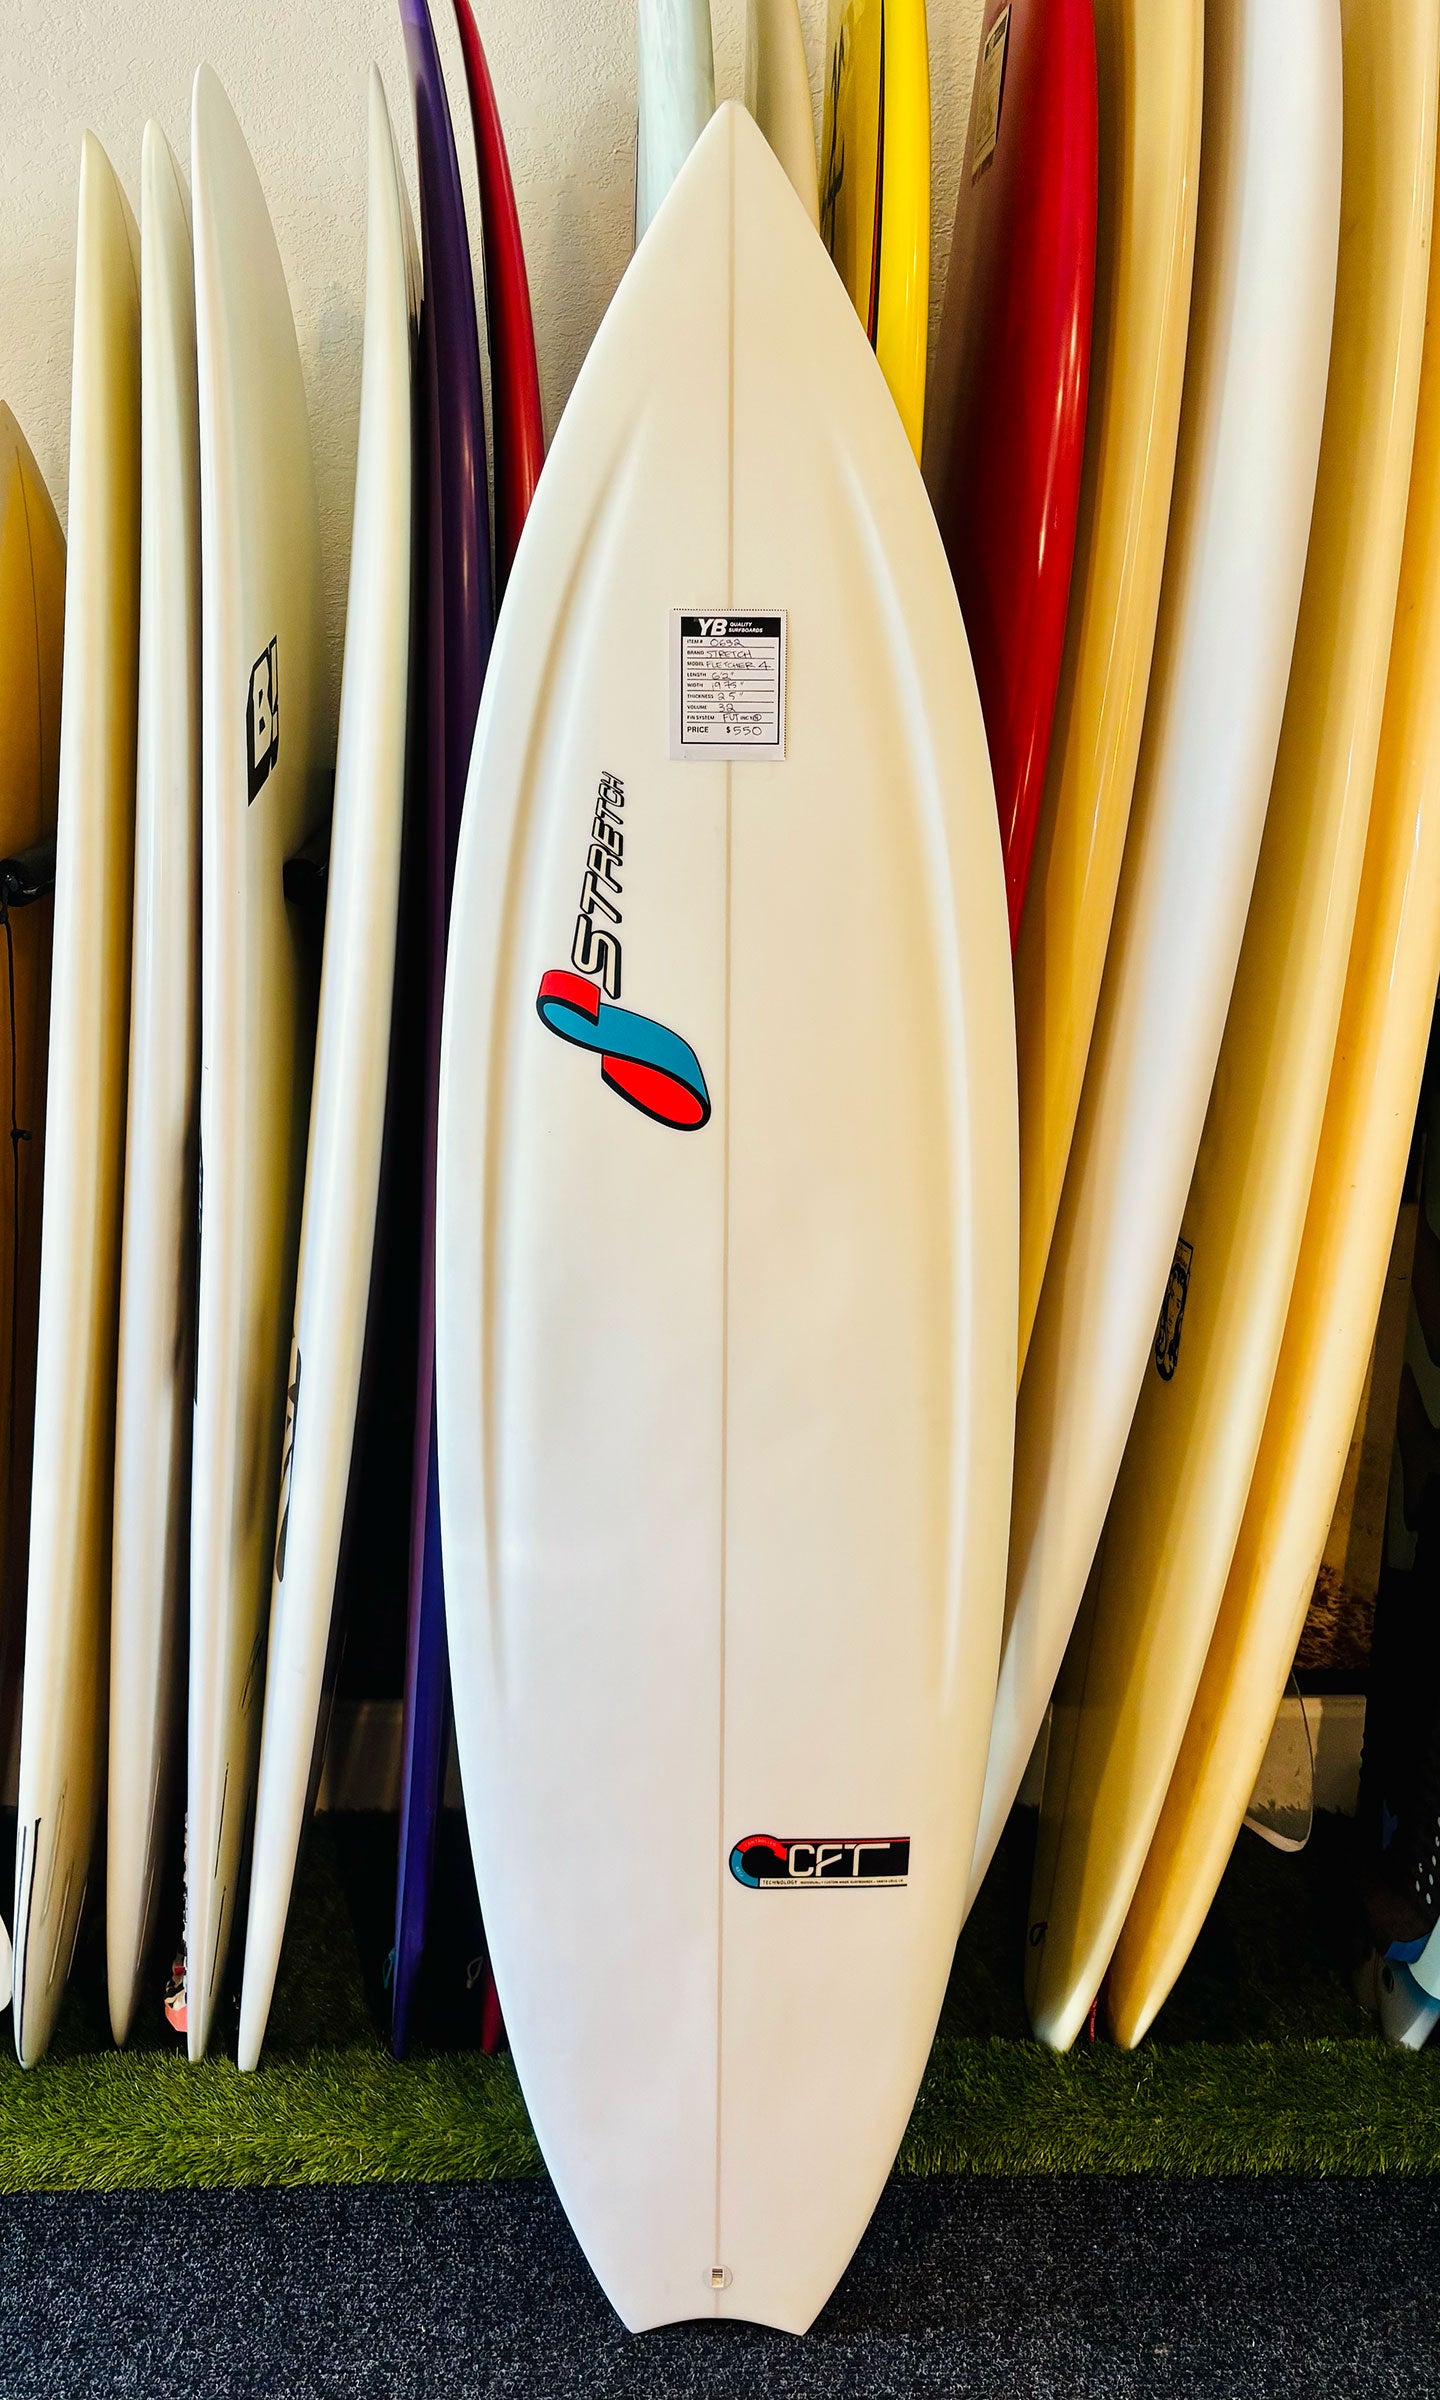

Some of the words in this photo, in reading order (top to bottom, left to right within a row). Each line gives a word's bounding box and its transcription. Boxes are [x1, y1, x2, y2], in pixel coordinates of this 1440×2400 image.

[698, 618, 728, 636] YB
[707, 650, 752, 658] STRETCH
[758, 661, 771, 670] 4
[571, 770, 625, 999] STRETCH
[788, 1843, 891, 1877] CFT
